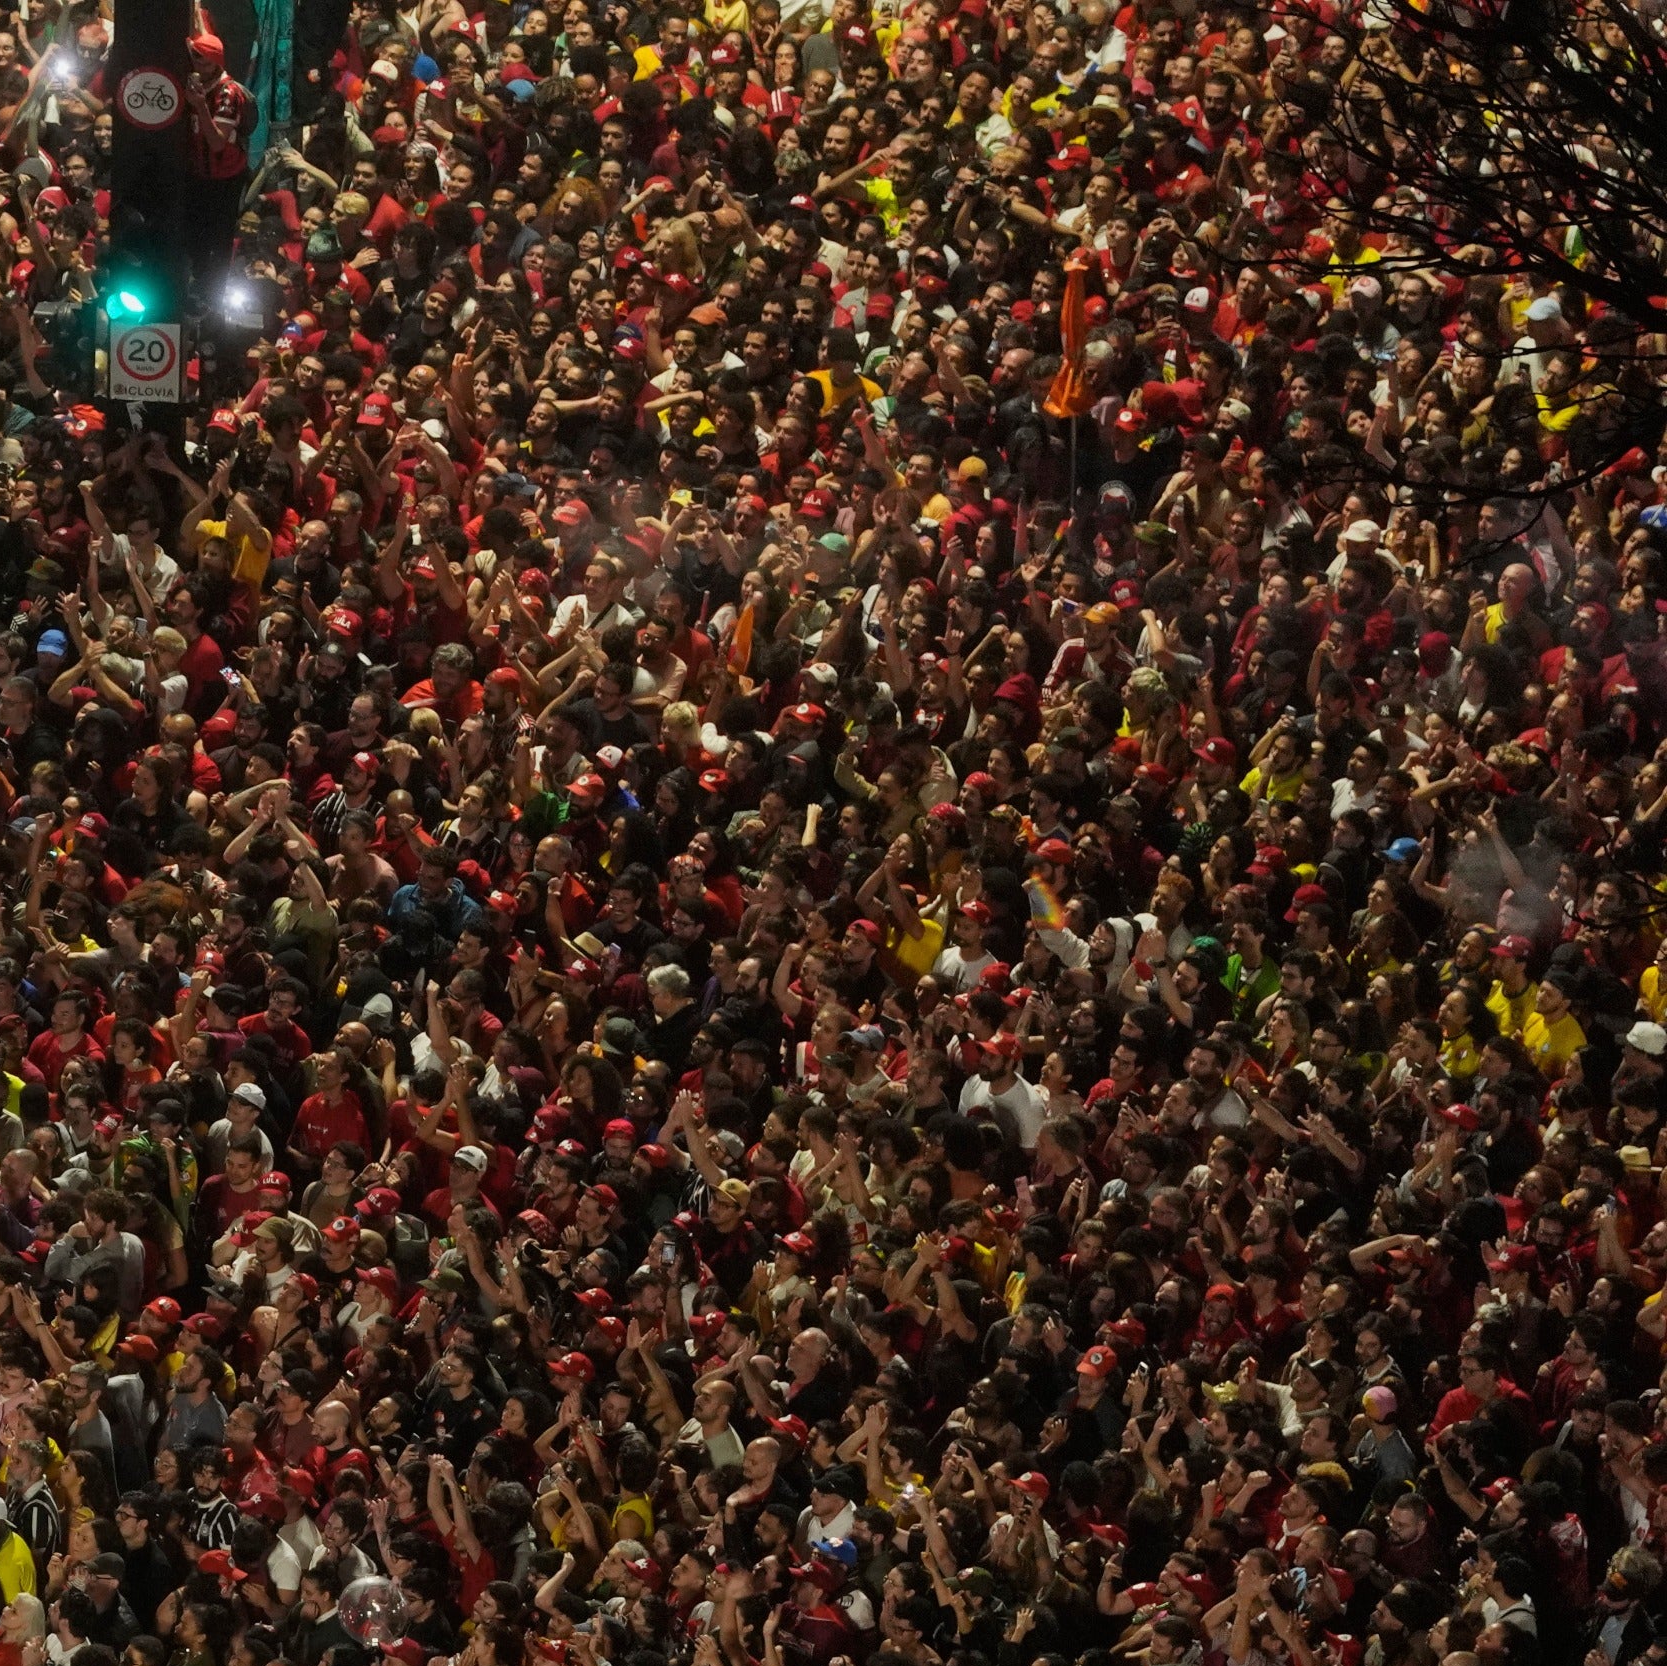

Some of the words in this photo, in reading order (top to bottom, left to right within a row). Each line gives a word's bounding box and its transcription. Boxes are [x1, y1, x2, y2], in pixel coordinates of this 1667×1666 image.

[128, 339, 165, 363] 20
[114, 384, 175, 398] ICLOVIA
[333, 617, 351, 629] LULA
